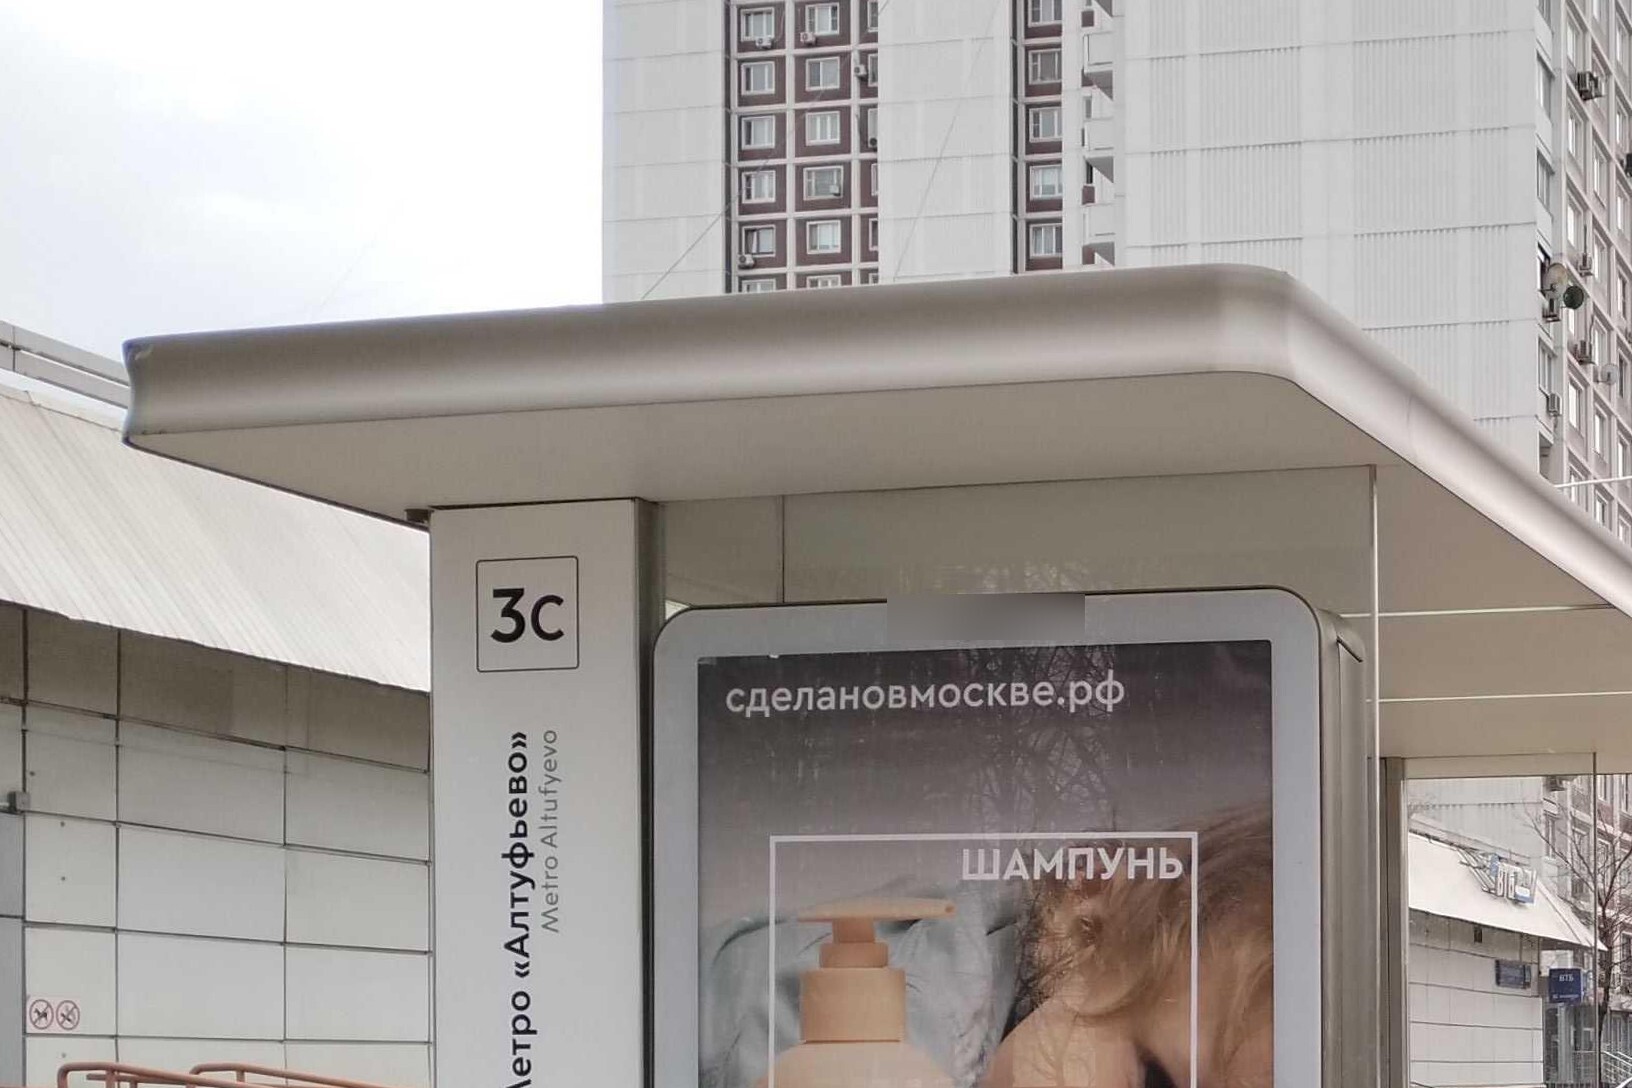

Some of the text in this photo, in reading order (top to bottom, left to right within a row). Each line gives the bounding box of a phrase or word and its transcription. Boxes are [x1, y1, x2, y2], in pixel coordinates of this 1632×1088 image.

[726, 670, 1125, 718] сделановмоскве.рф
[501, 731, 535, 978] «Алтуфьево»
[538, 730, 562, 933] Metro Altufyevo
[961, 847, 1184, 881] ШАМПУНЬ
